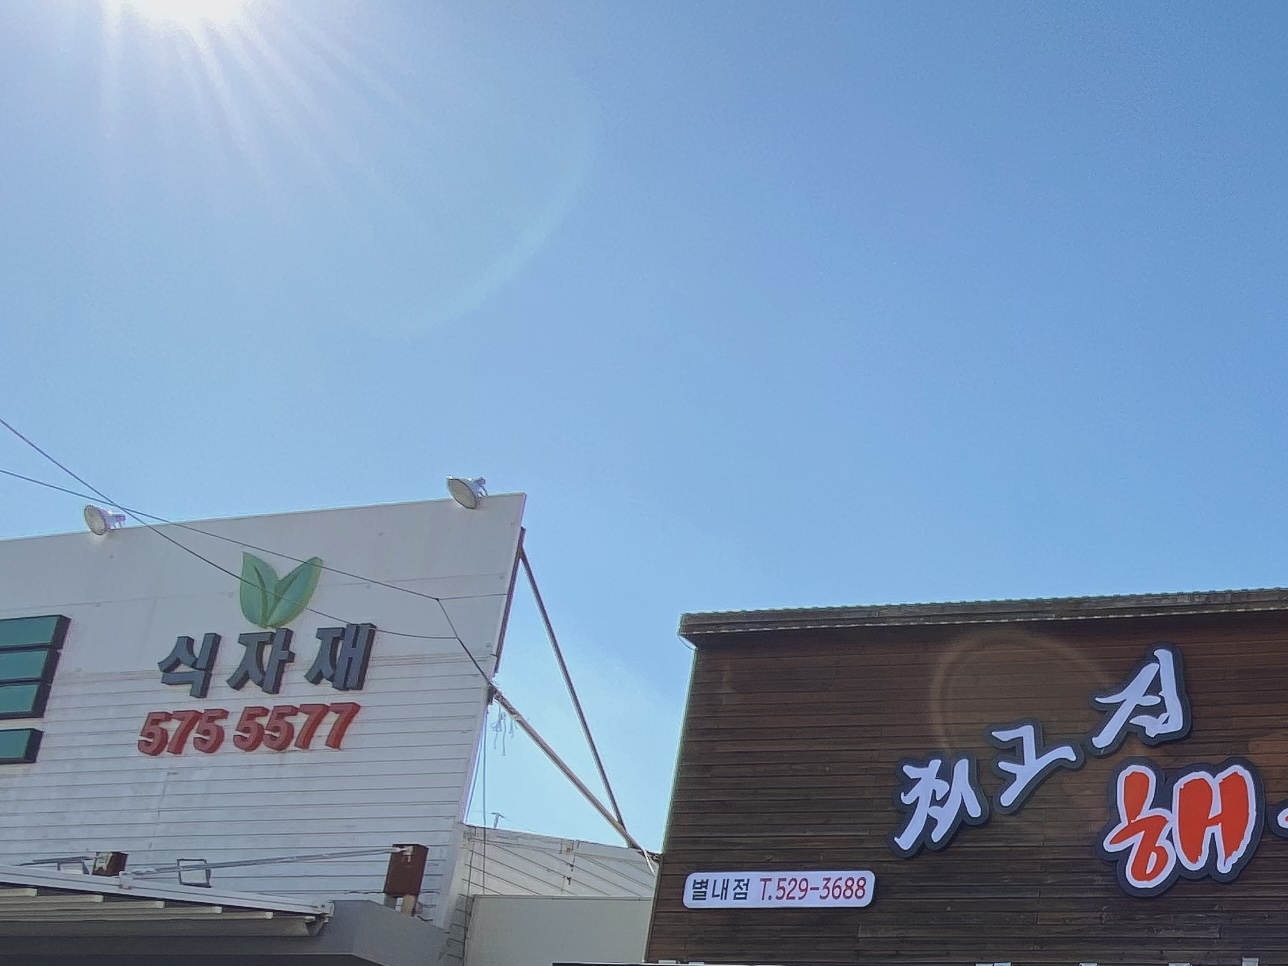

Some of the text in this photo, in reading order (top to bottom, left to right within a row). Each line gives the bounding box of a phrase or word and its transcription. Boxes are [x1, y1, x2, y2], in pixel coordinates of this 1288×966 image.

[157, 622, 377, 699] 식자재
[137, 702, 361, 756] 575 5577
[894, 648, 1184, 851] 최고집
[692, 876, 867, 901] 별내점 T.529-3688
